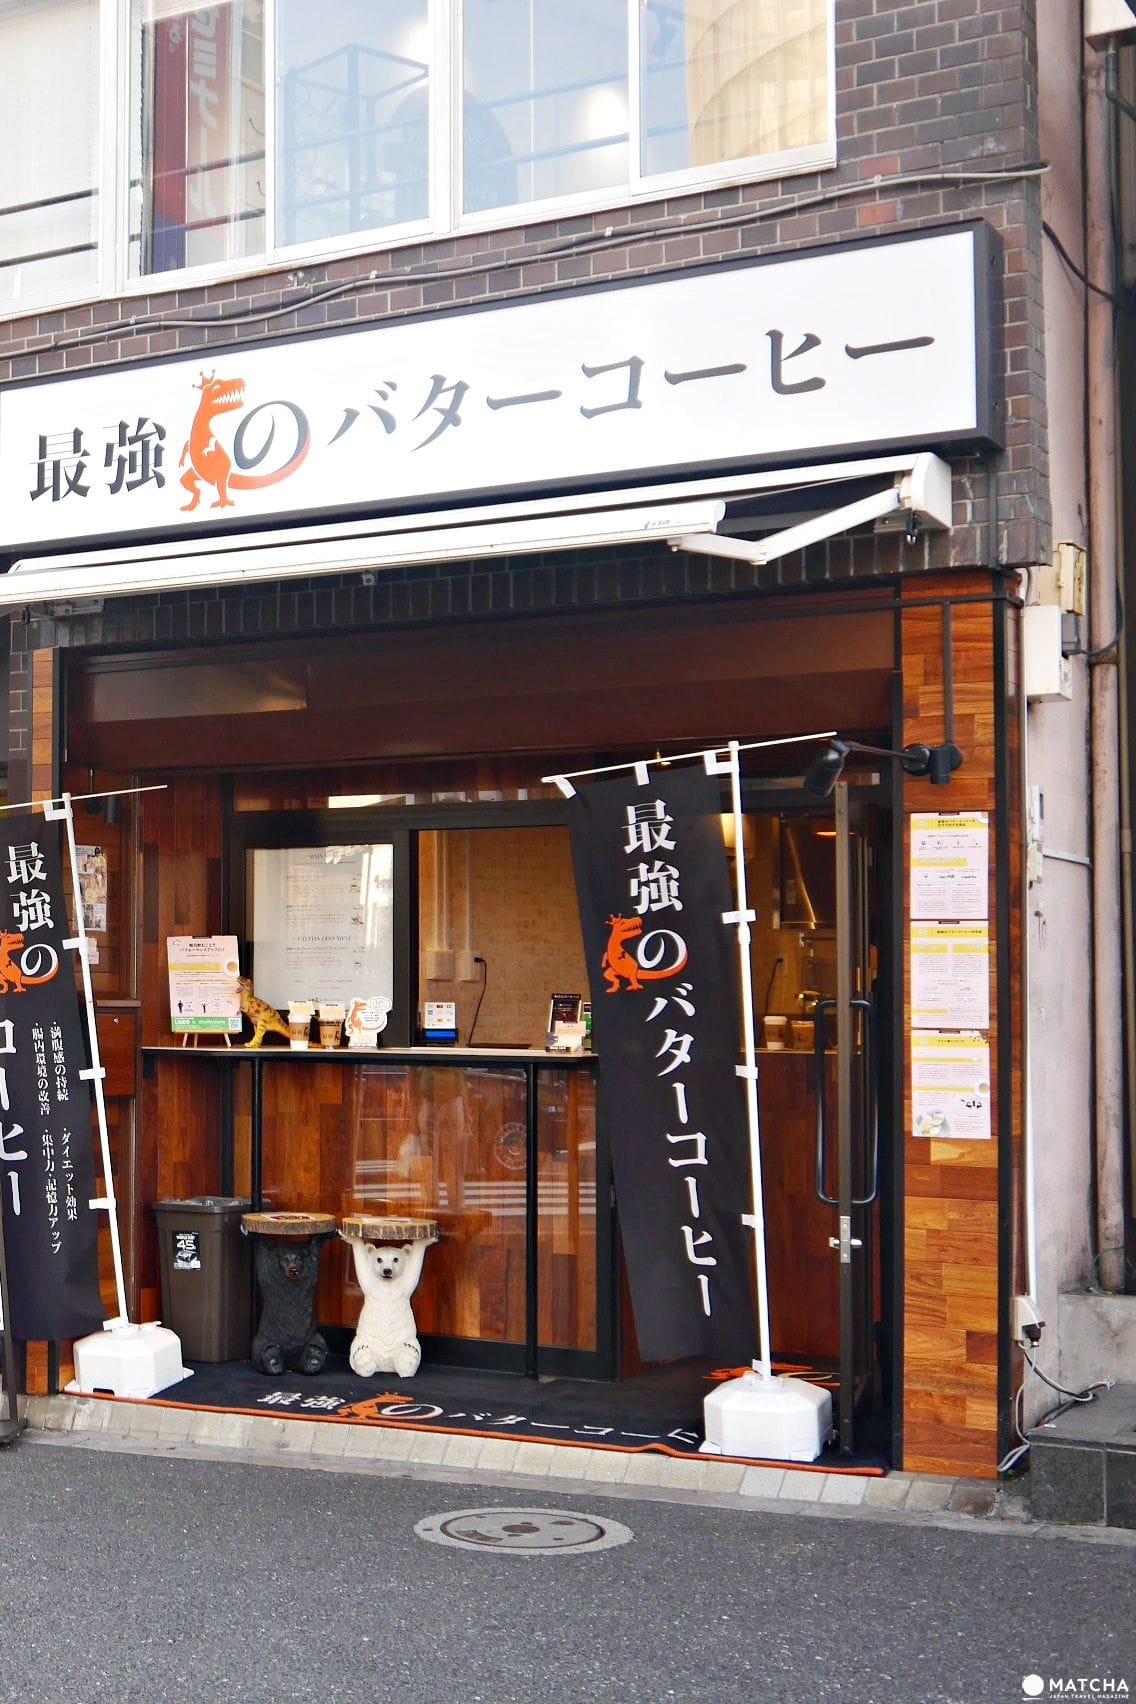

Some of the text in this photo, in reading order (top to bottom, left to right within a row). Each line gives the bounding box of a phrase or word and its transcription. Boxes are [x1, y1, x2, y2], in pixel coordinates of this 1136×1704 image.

[29, 329, 936, 508] 最強のバターコーヒー
[621, 800, 718, 1317] 最強のバターコーヒー
[256, 1390, 701, 1444] 最強のバターコーヒ
